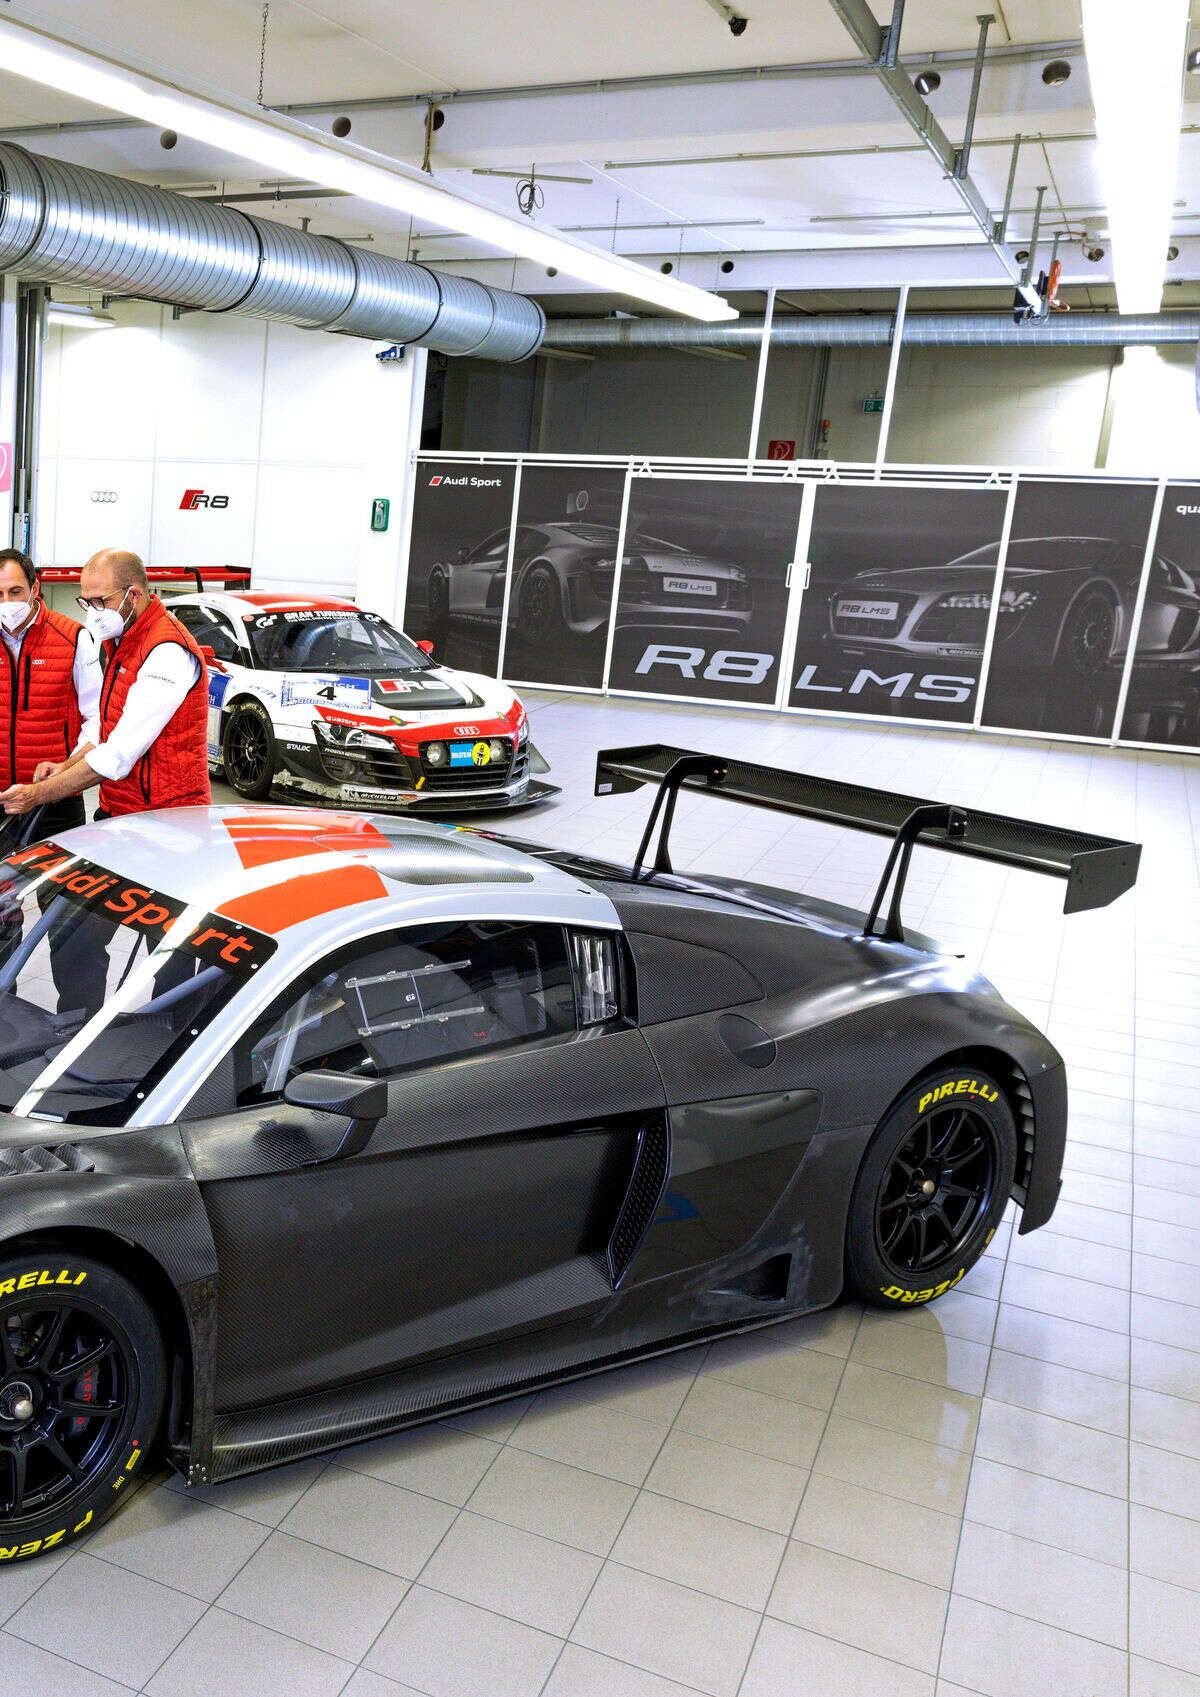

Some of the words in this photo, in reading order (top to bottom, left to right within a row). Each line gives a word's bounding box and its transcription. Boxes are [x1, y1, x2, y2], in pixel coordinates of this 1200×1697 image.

[443, 476, 468, 486] Audi
[470, 477, 502, 488] Sport
[190, 493, 230, 509] R8
[1176, 505, 1200, 515] qu
[668, 581, 689, 591] R8
[284, 610, 313, 620] GRAN
[314, 609, 360, 619] TURISMO
[840, 603, 861, 614] R8
[862, 605, 891, 615] LMS
[635, 644, 776, 686] R8
[392, 680, 450, 692] R8
[795, 664, 977, 704] LMS
[316, 686, 337, 701] 4
[326, 715, 358, 726] quattro
[286, 743, 311, 752] STALOC
[360, 792, 398, 801] MICHELIN
[29, 855, 119, 899] Audi
[918, 1079, 999, 1114] PIRELLI
[951, 1267, 965, 1290] P
[883, 1279, 951, 1304] ZERO
[112, 1475, 126, 1490] DHE
[74, 1509, 95, 1533] P
